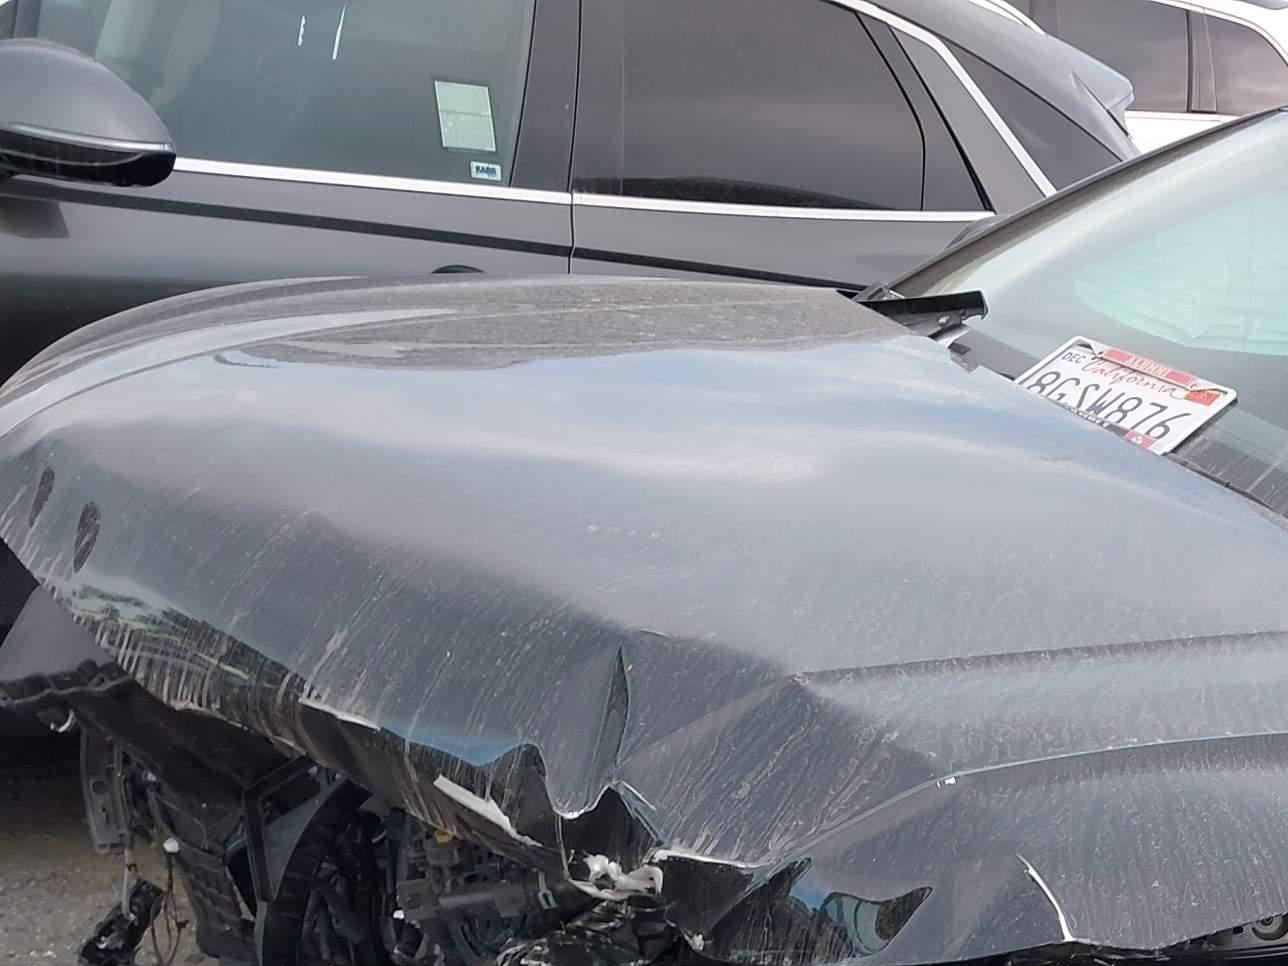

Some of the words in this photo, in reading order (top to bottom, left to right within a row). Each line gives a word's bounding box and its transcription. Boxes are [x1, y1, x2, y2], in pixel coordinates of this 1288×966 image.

[1060, 350, 1086, 365] DEC
[1081, 356, 1186, 400] California
[1026, 371, 1192, 442] 8GSW876
